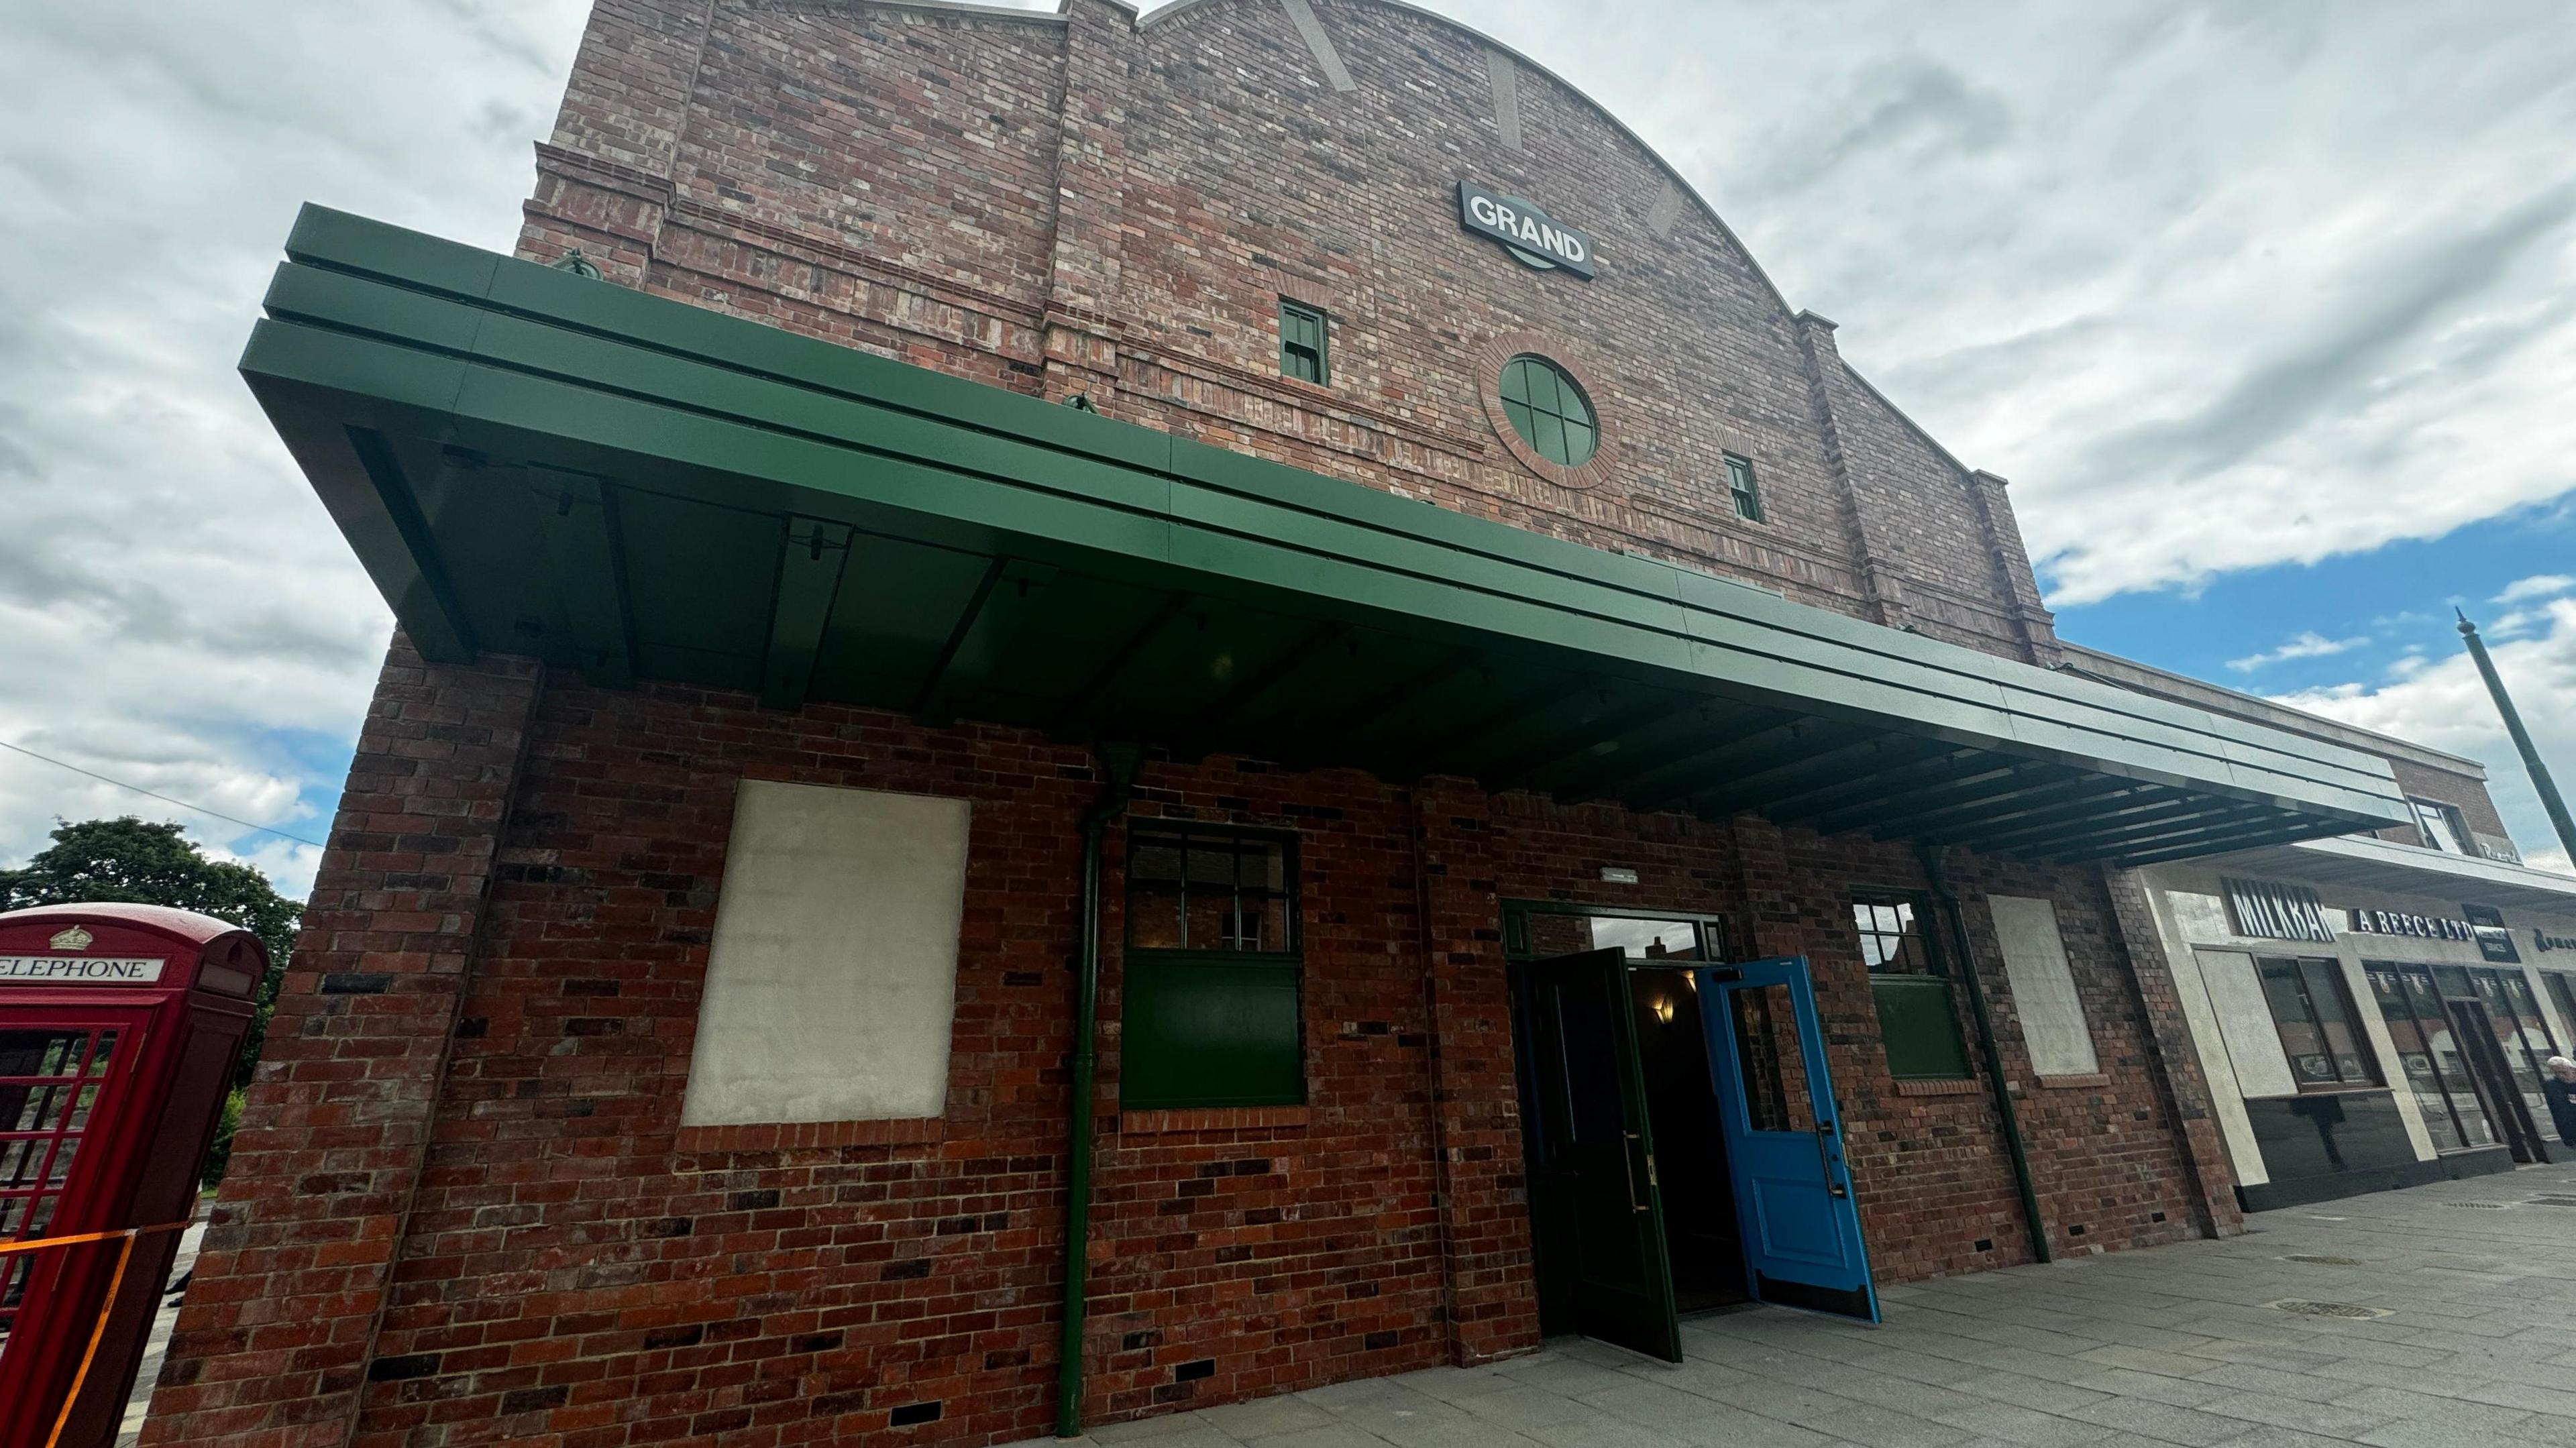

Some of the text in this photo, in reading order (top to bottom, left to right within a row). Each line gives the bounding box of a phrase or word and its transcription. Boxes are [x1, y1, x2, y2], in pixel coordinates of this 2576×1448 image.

[1470, 196, 1585, 262] GRAND
[2359, 909, 2373, 932] A
[2375, 911, 2439, 937] REECE
[2440, 918, 2477, 941] LTD
[0, 959, 146, 978] ELEPHONE
